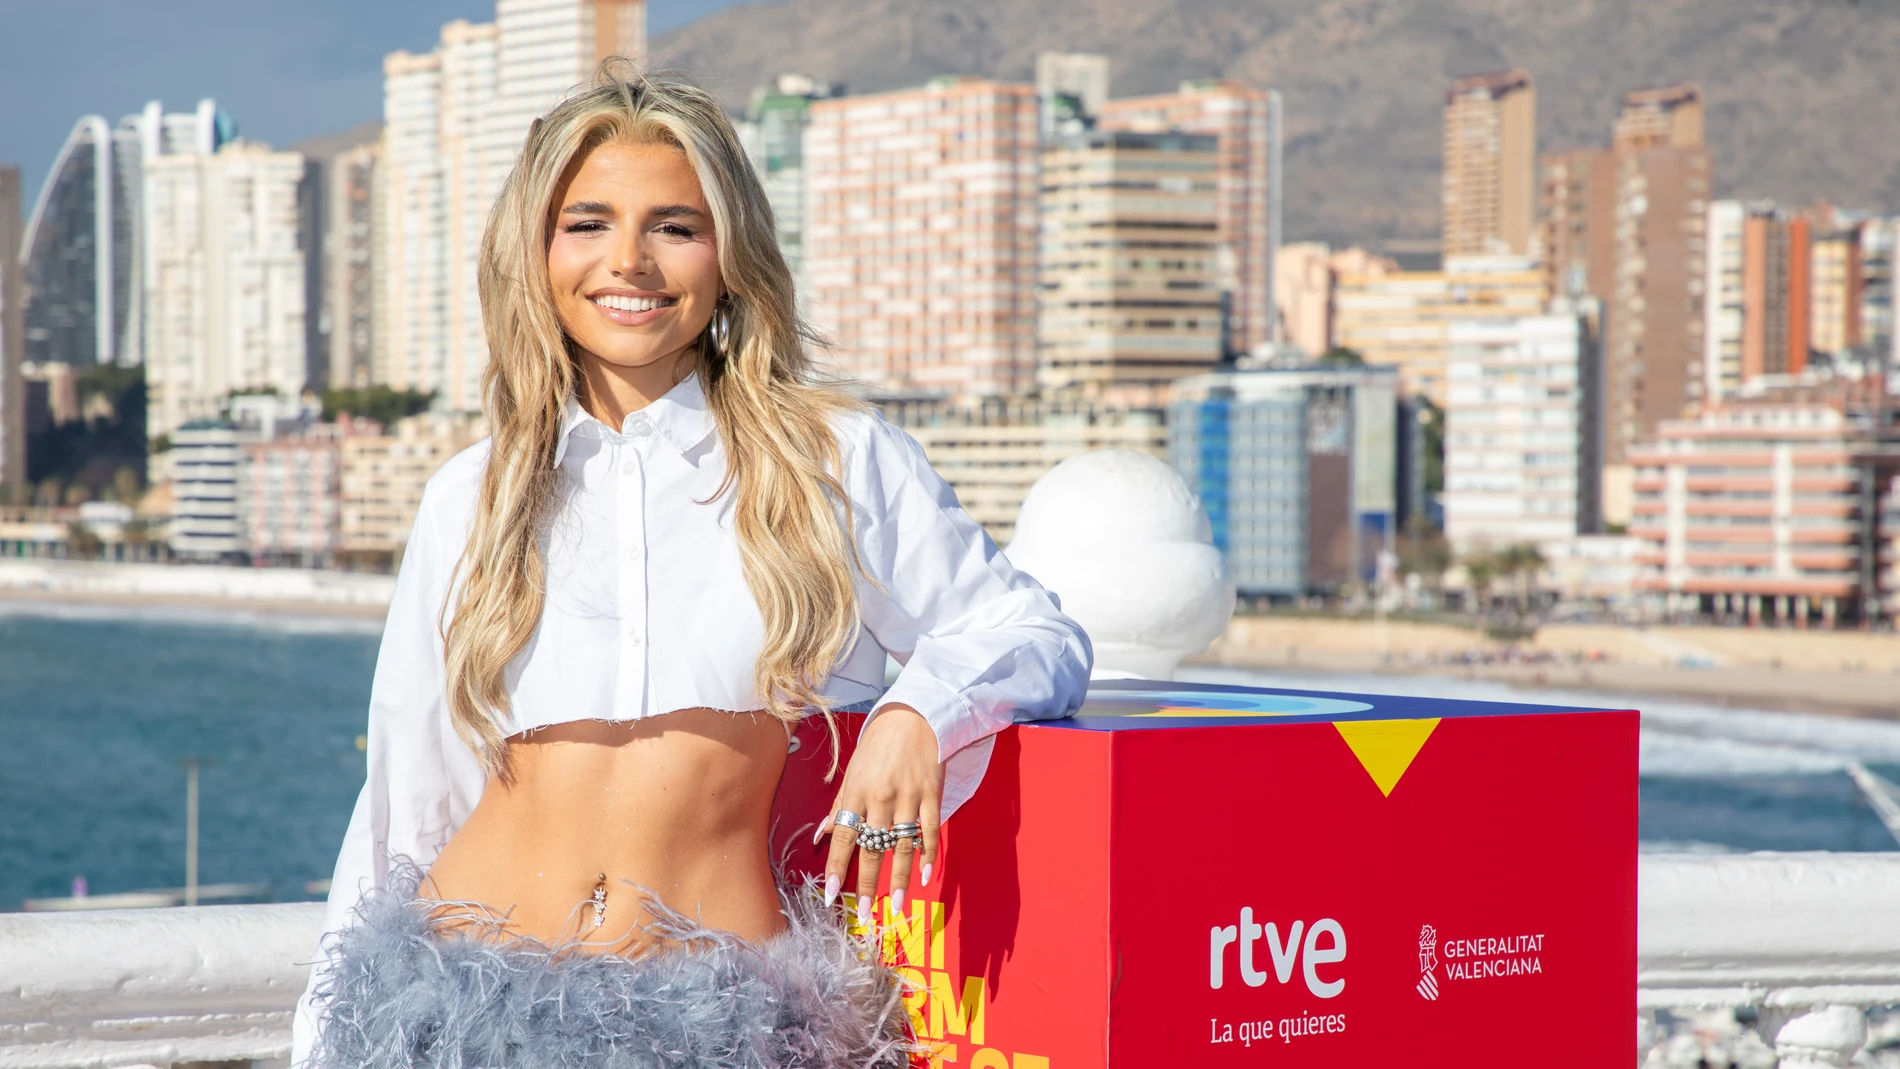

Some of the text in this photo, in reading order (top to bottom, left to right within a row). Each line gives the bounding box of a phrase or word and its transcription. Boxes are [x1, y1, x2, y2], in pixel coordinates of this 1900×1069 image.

[816, 889, 945, 970] ENI
[1444, 934, 1545, 958] GENERALITAT
[1210, 906, 1347, 999] rtve
[1445, 957, 1542, 981] VALENCIANA
[1210, 1009, 1346, 1048] La que quieres
